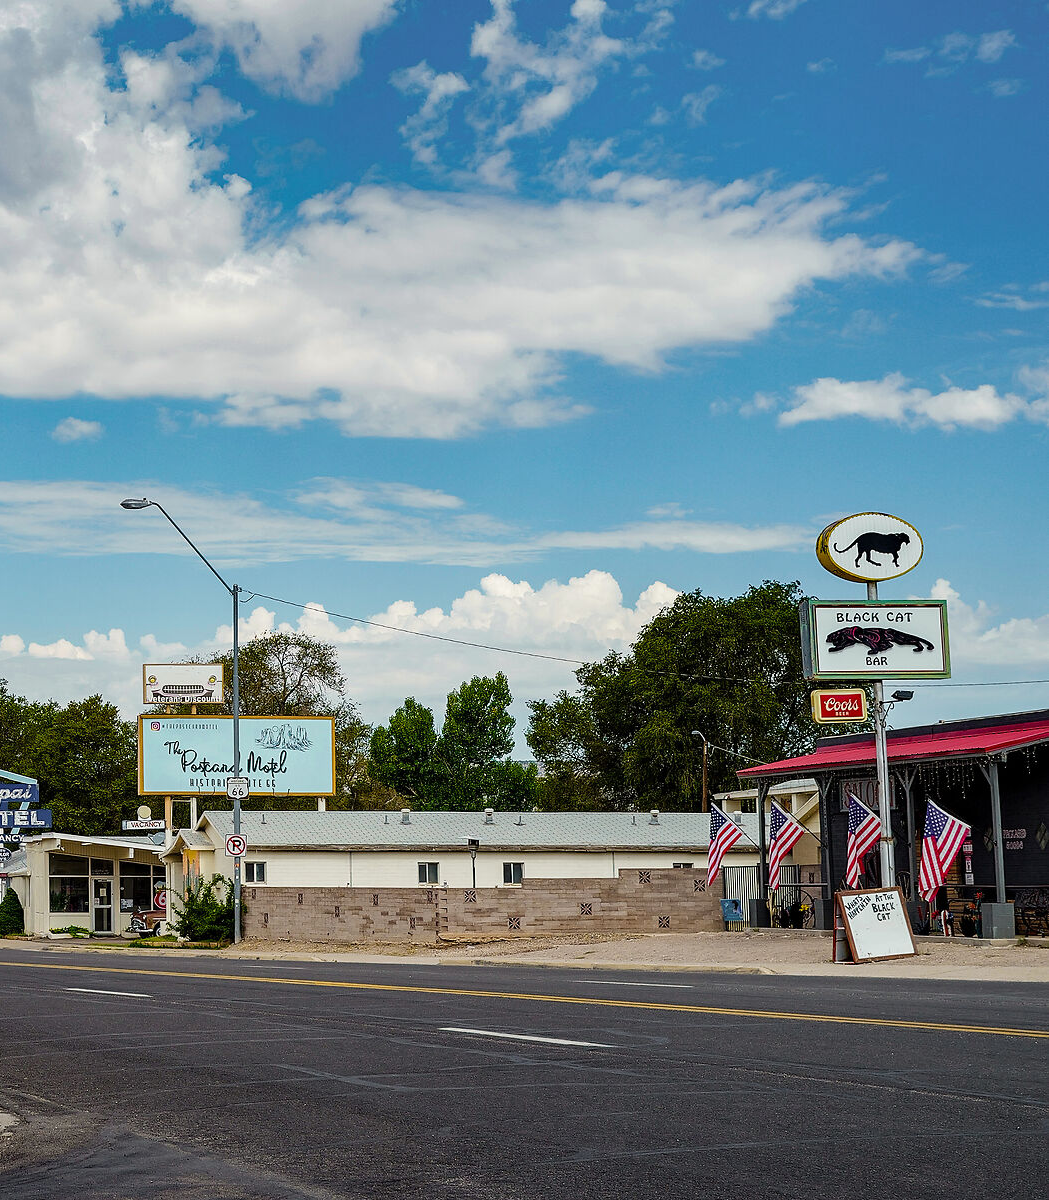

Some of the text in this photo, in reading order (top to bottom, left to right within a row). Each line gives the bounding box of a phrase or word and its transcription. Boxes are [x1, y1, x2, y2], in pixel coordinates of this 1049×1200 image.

[836, 611, 913, 623] BLACK CAT
[865, 656, 888, 666] BAR
[823, 697, 859, 712] Coors
[163, 740, 183, 755] The
[247, 749, 288, 778] Motel
[189, 778, 226, 787] HISTORI
[231, 787, 245, 796] 66
[875, 894, 883, 903] AT
[871, 902, 896, 913] BLACK
[876, 912, 891, 921] CAT
